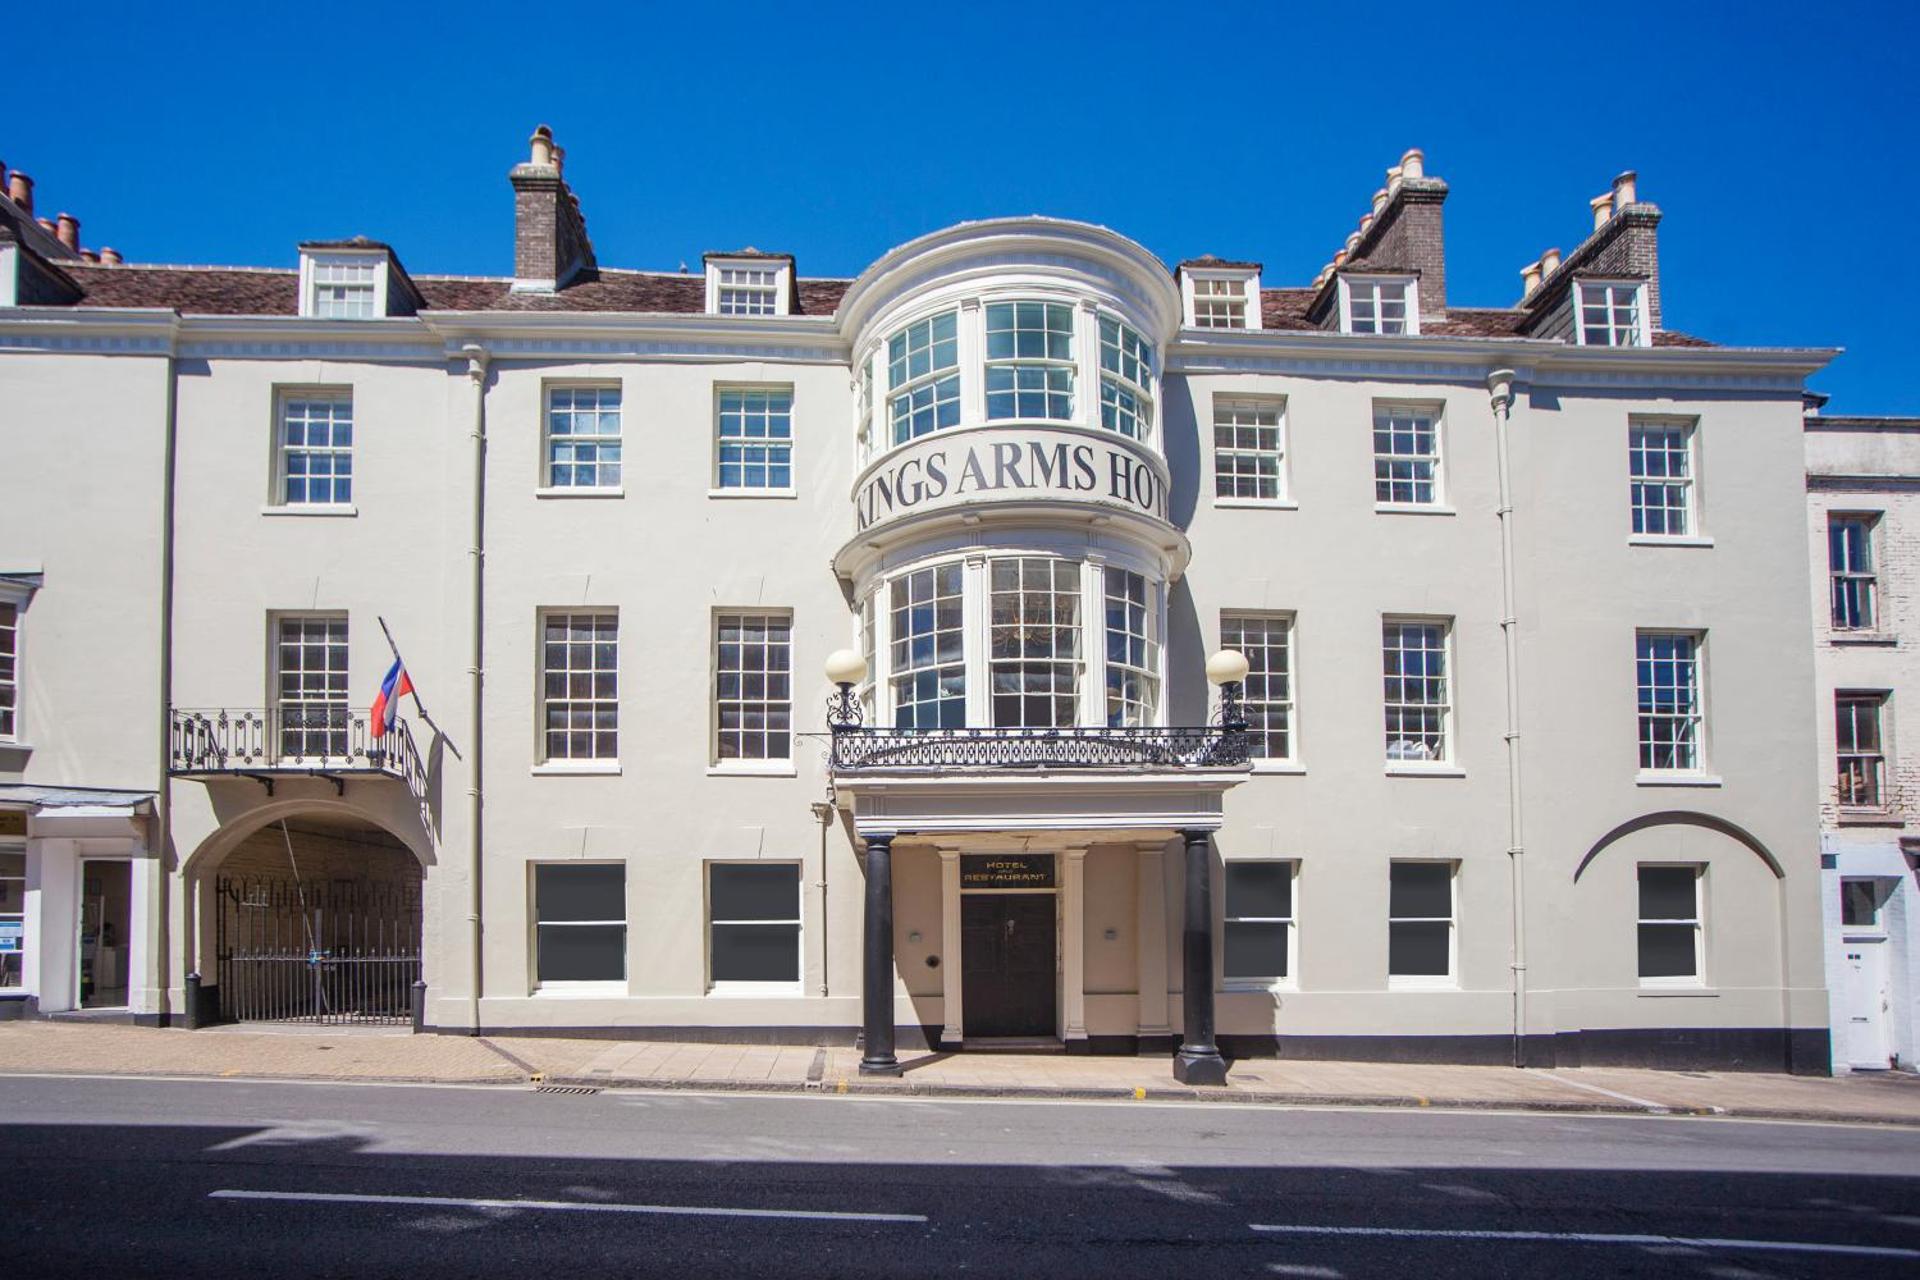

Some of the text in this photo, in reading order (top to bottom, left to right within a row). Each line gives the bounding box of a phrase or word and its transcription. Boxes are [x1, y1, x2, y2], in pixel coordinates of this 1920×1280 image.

[857, 442, 1167, 531] KINGS ARMS HOT
